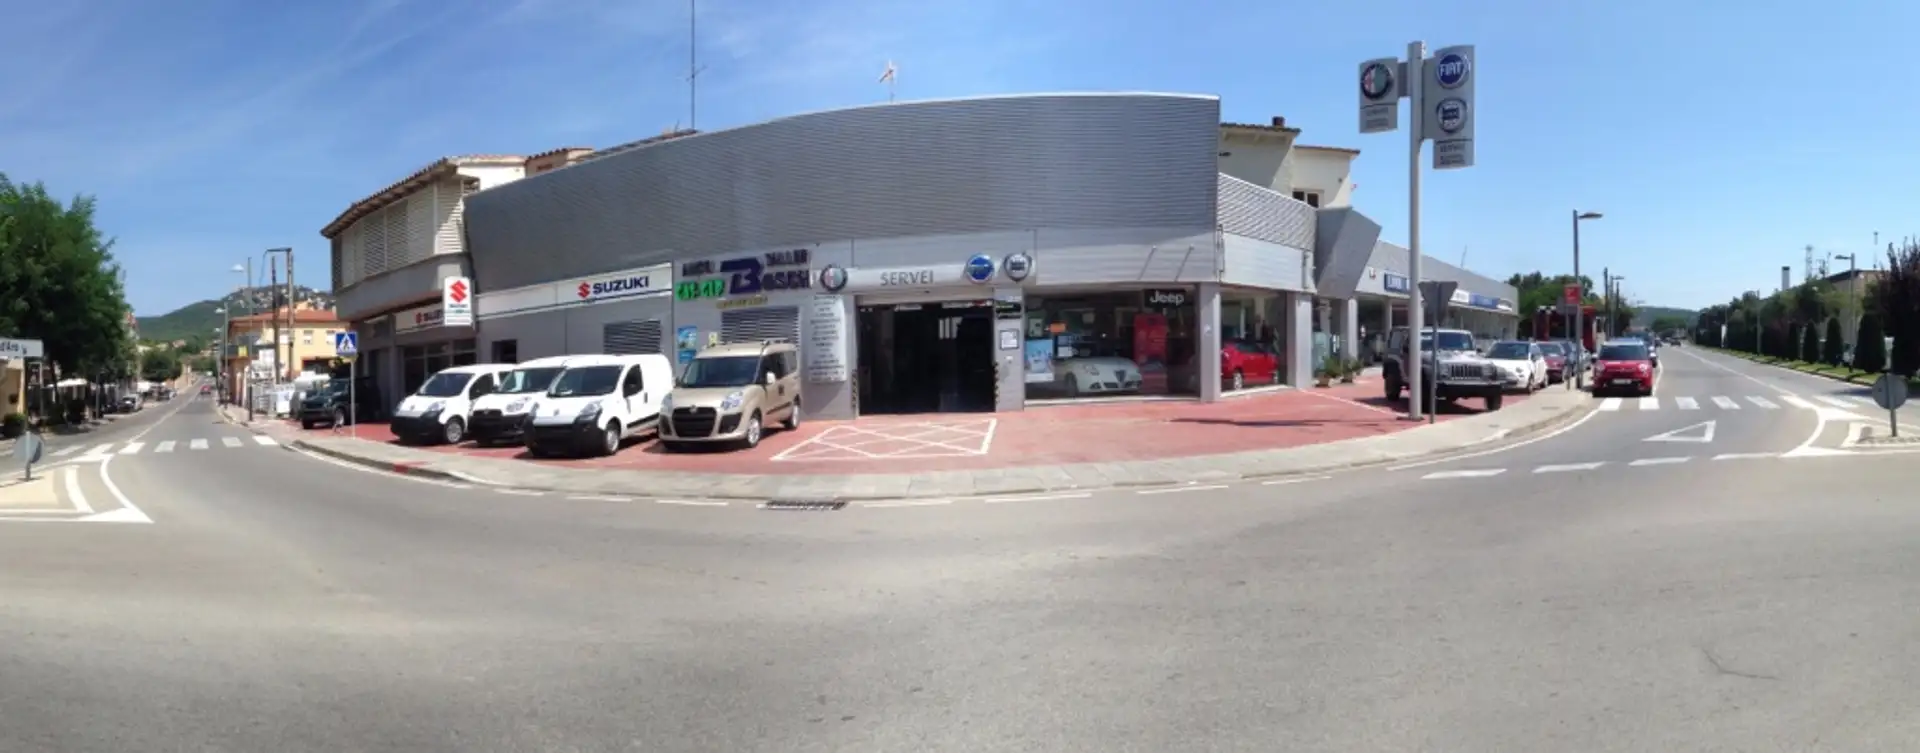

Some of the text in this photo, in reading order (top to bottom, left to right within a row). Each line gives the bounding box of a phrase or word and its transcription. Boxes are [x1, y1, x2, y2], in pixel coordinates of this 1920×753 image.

[1440, 62, 1463, 76] FIAT
[593, 276, 649, 295] SUZUKI
[880, 270, 934, 287] SERVEI
[1149, 290, 1185, 305] Jeep
